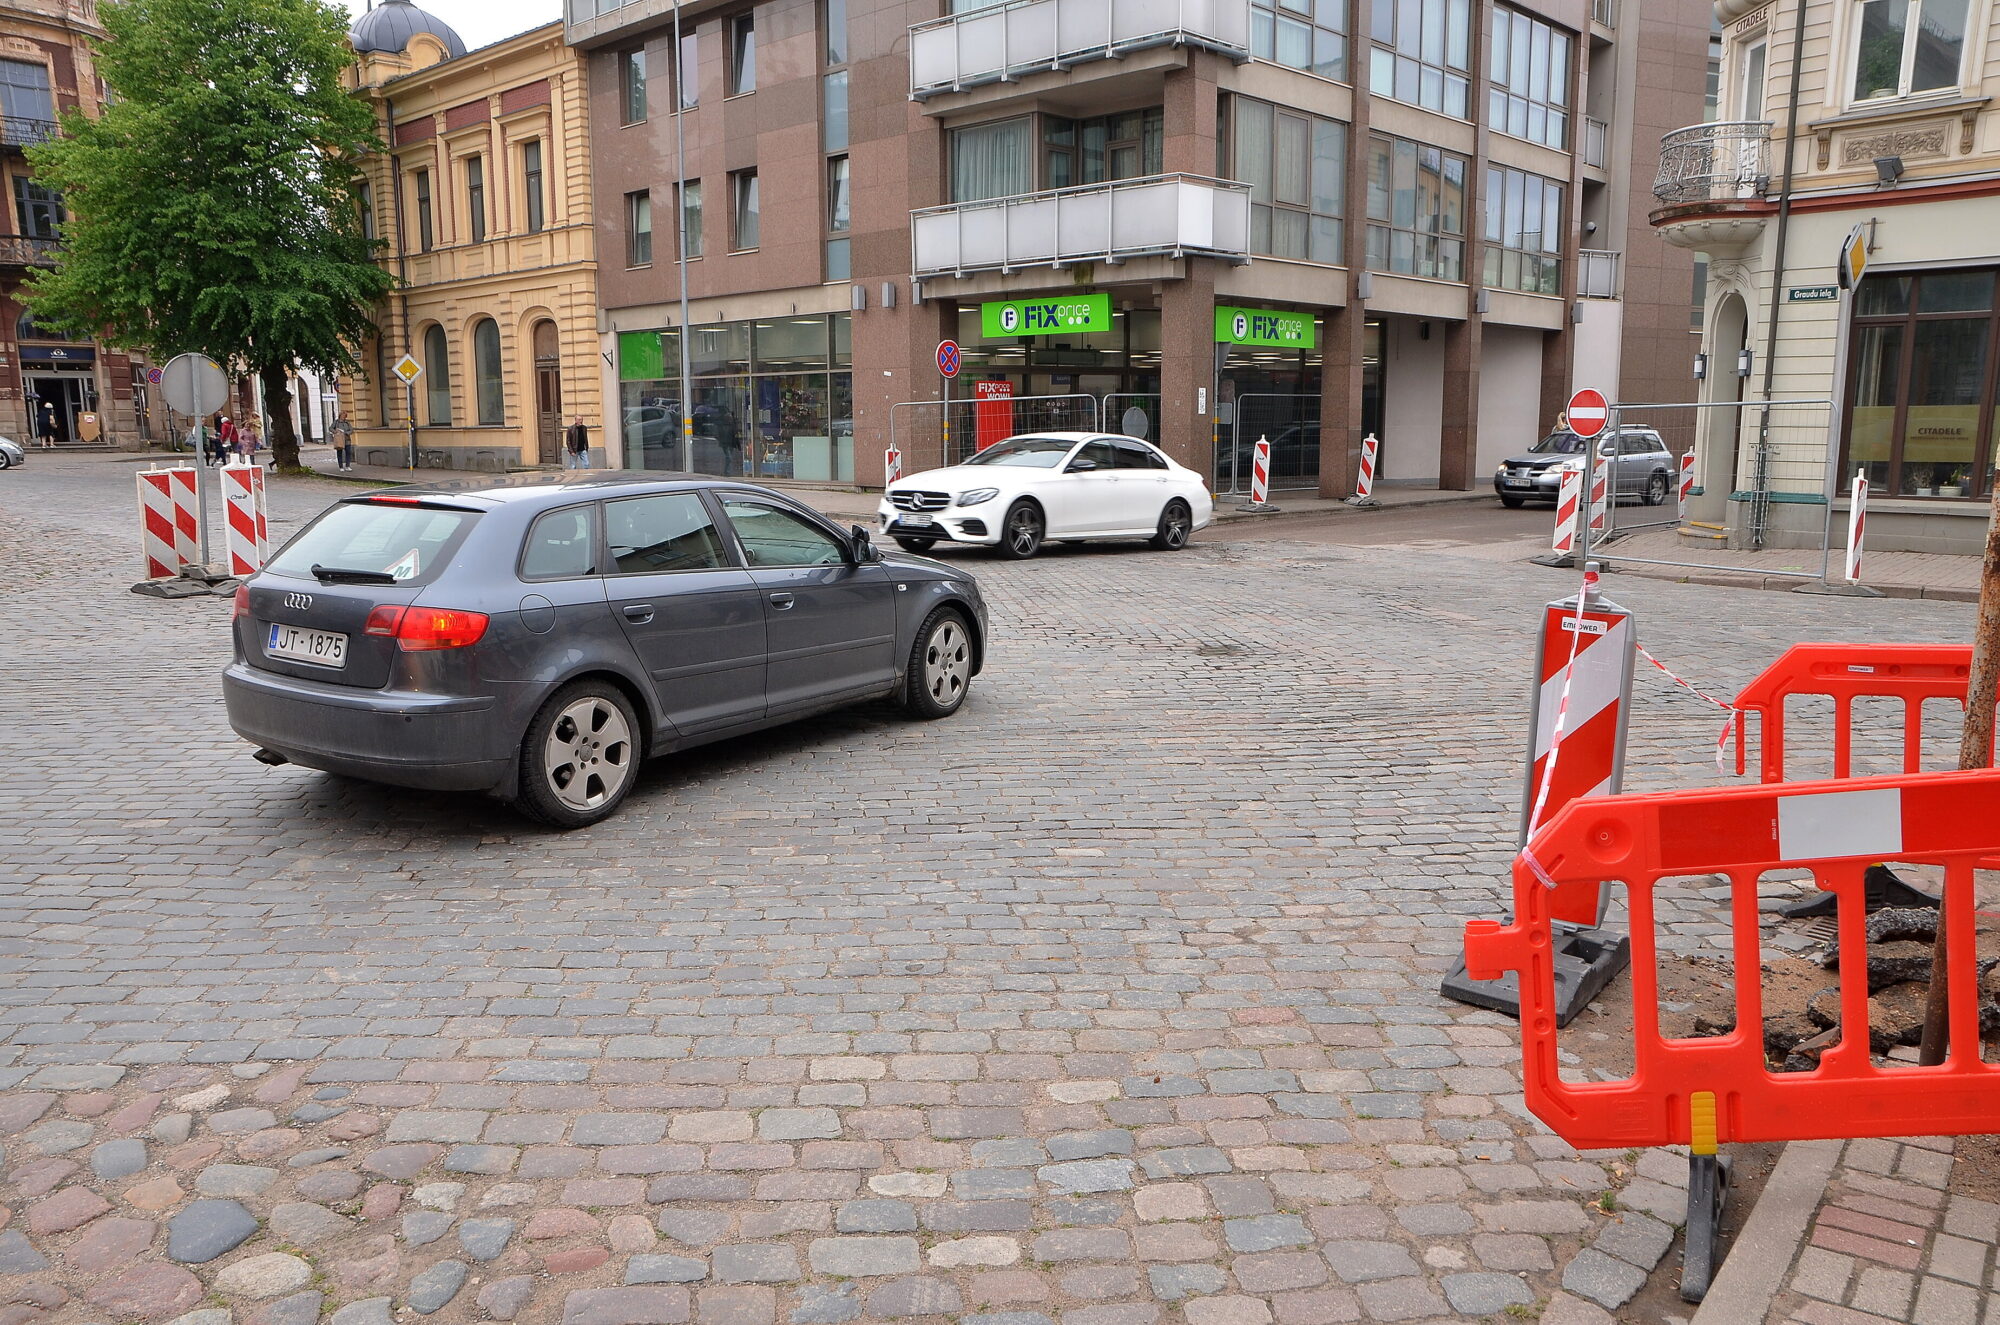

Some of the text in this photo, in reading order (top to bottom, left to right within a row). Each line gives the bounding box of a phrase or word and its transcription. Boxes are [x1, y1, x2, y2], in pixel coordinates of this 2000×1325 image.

[1736, 7, 1768, 33] CITADELE
[1794, 289, 1832, 299] Graudu iela
[1918, 427, 1962, 435] CITADELE
